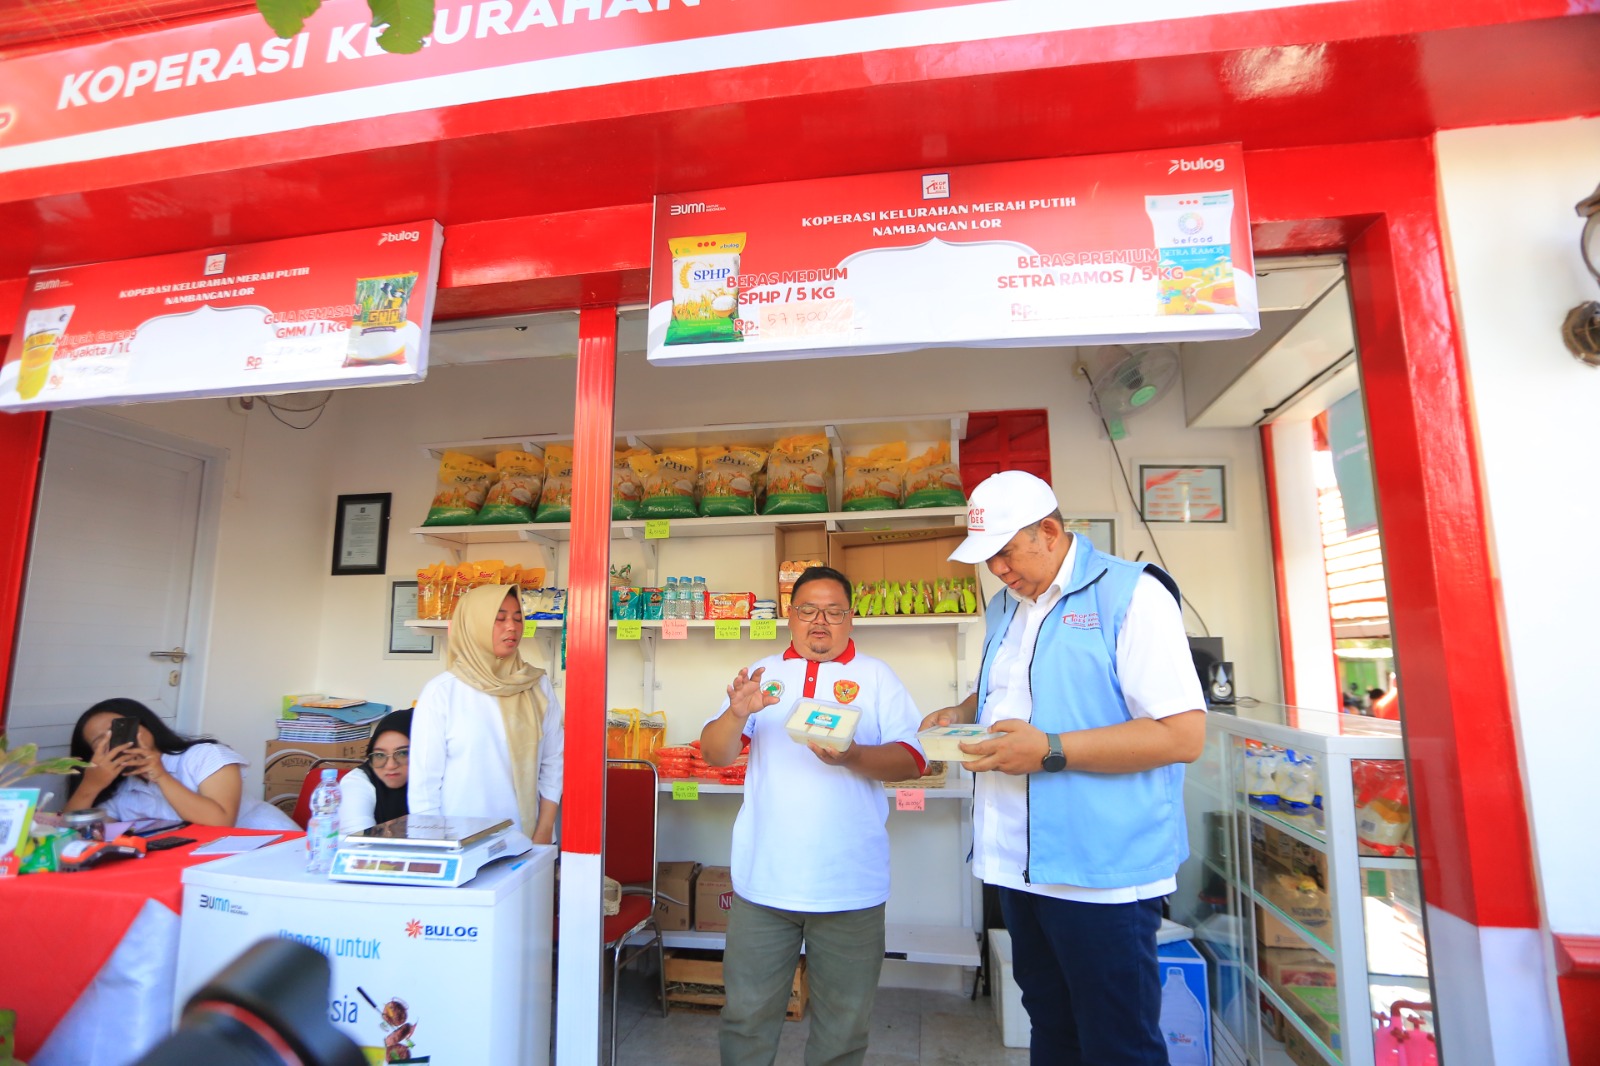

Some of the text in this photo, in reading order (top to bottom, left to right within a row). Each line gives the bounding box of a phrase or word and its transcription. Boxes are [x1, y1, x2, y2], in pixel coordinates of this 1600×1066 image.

[56, 32, 309, 110] KOPERASI
[1180, 158, 1225, 172] bulog
[802, 197, 1077, 227] KOPERASI KELURAHAN MERAH PUTIH
[872, 218, 1003, 236] NAMBANGAN LOR
[387, 230, 420, 242] bulog
[1173, 236, 1214, 245] befood
[1017, 248, 1161, 269] BERAS PREMIUM
[1191, 246, 1225, 256] RAMOS
[118, 266, 311, 299] KOPERASI KELURAHAN MERAH PUTIH
[693, 267, 731, 281] SPHP
[726, 267, 849, 289] BERAS MEDIUM
[997, 273, 1056, 289] SETRA
[1059, 270, 1125, 286] RAMOS
[1142, 266, 1153, 281] 5
[1158, 267, 1185, 280] KG
[164, 287, 256, 305] NAMBANGAN LOR
[738, 286, 836, 305] SPHP / 5 KG
[263, 303, 363, 326] GULA KEMASAN
[368, 308, 401, 324] GMM
[276, 325, 308, 339] GMM
[733, 318, 759, 334] Rp.
[246, 355, 263, 369] Rp
[971, 516, 984, 524] DES
[425, 925, 479, 938] BULOG
[335, 937, 381, 960] untuk
